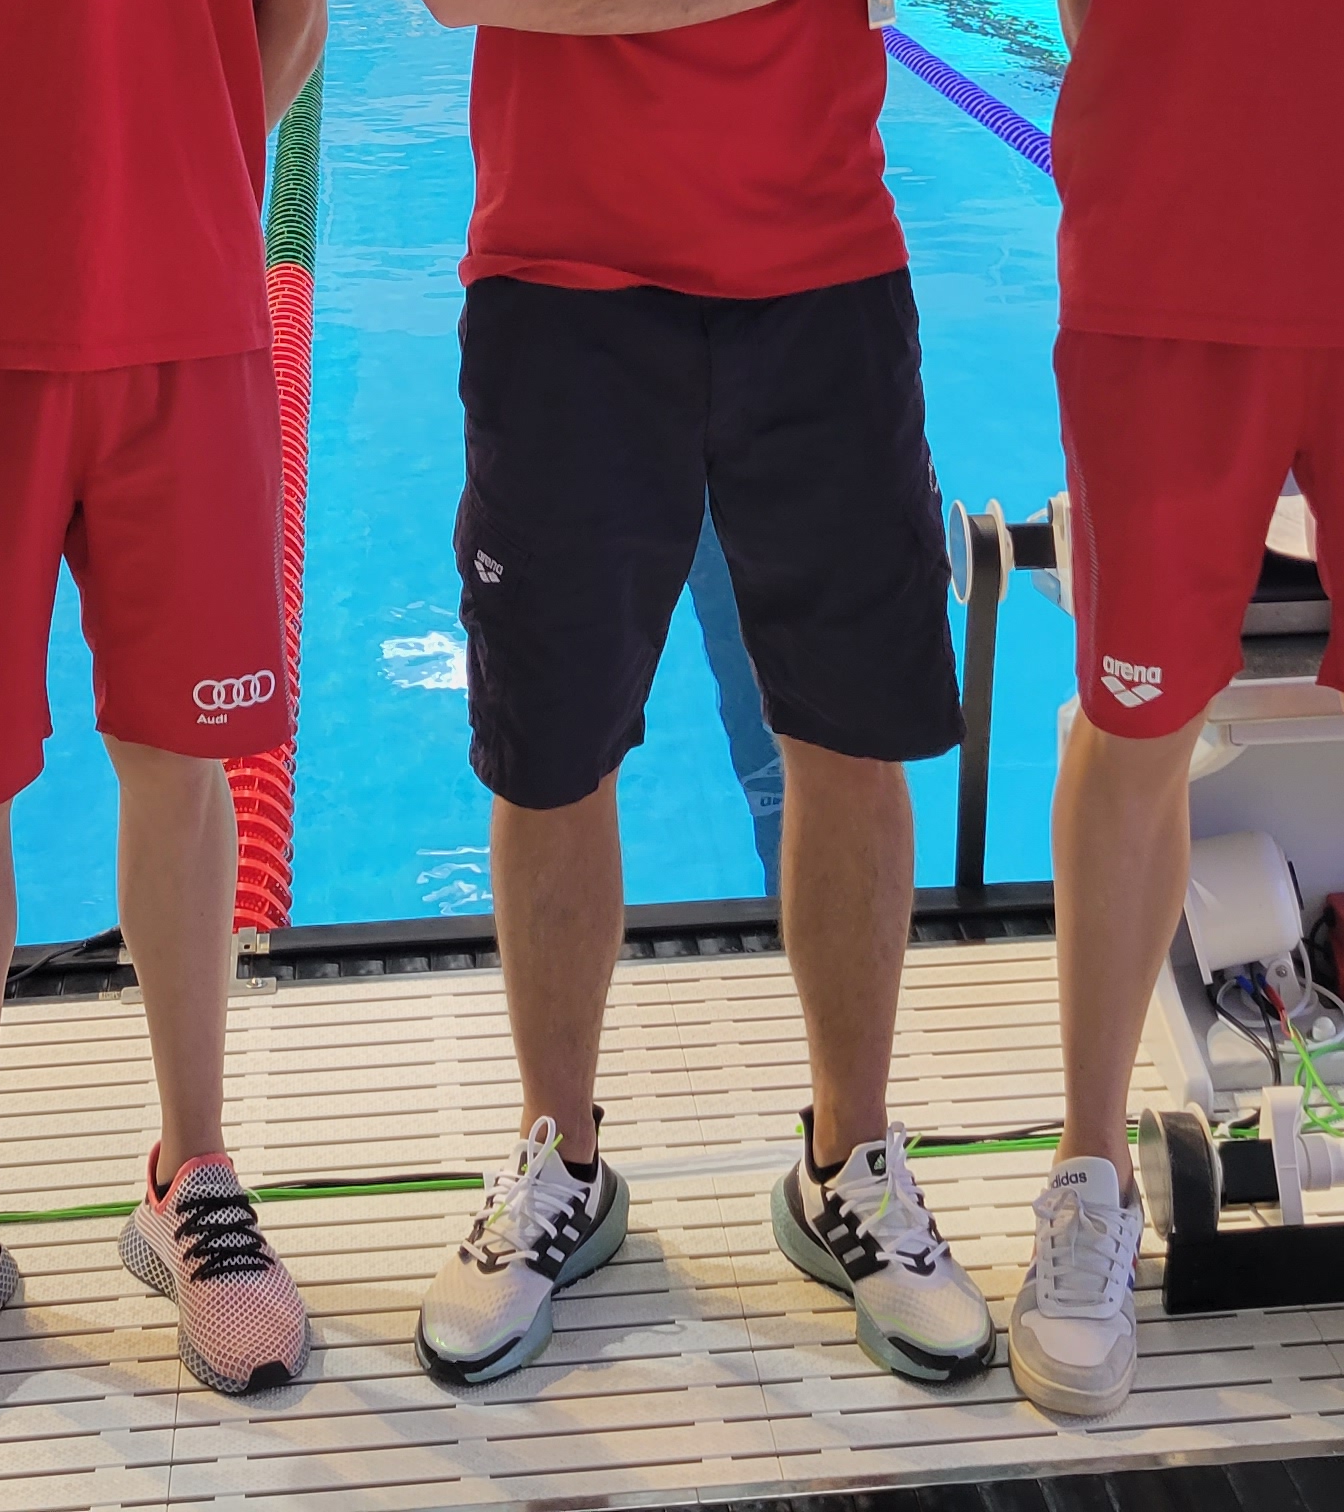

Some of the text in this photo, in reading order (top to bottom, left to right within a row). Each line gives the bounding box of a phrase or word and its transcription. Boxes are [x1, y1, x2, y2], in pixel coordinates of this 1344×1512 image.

[477, 549, 504, 576] arena
[1102, 655, 1162, 684] arena
[196, 713, 228, 726] Audi
[1051, 1170, 1088, 1189] didas
